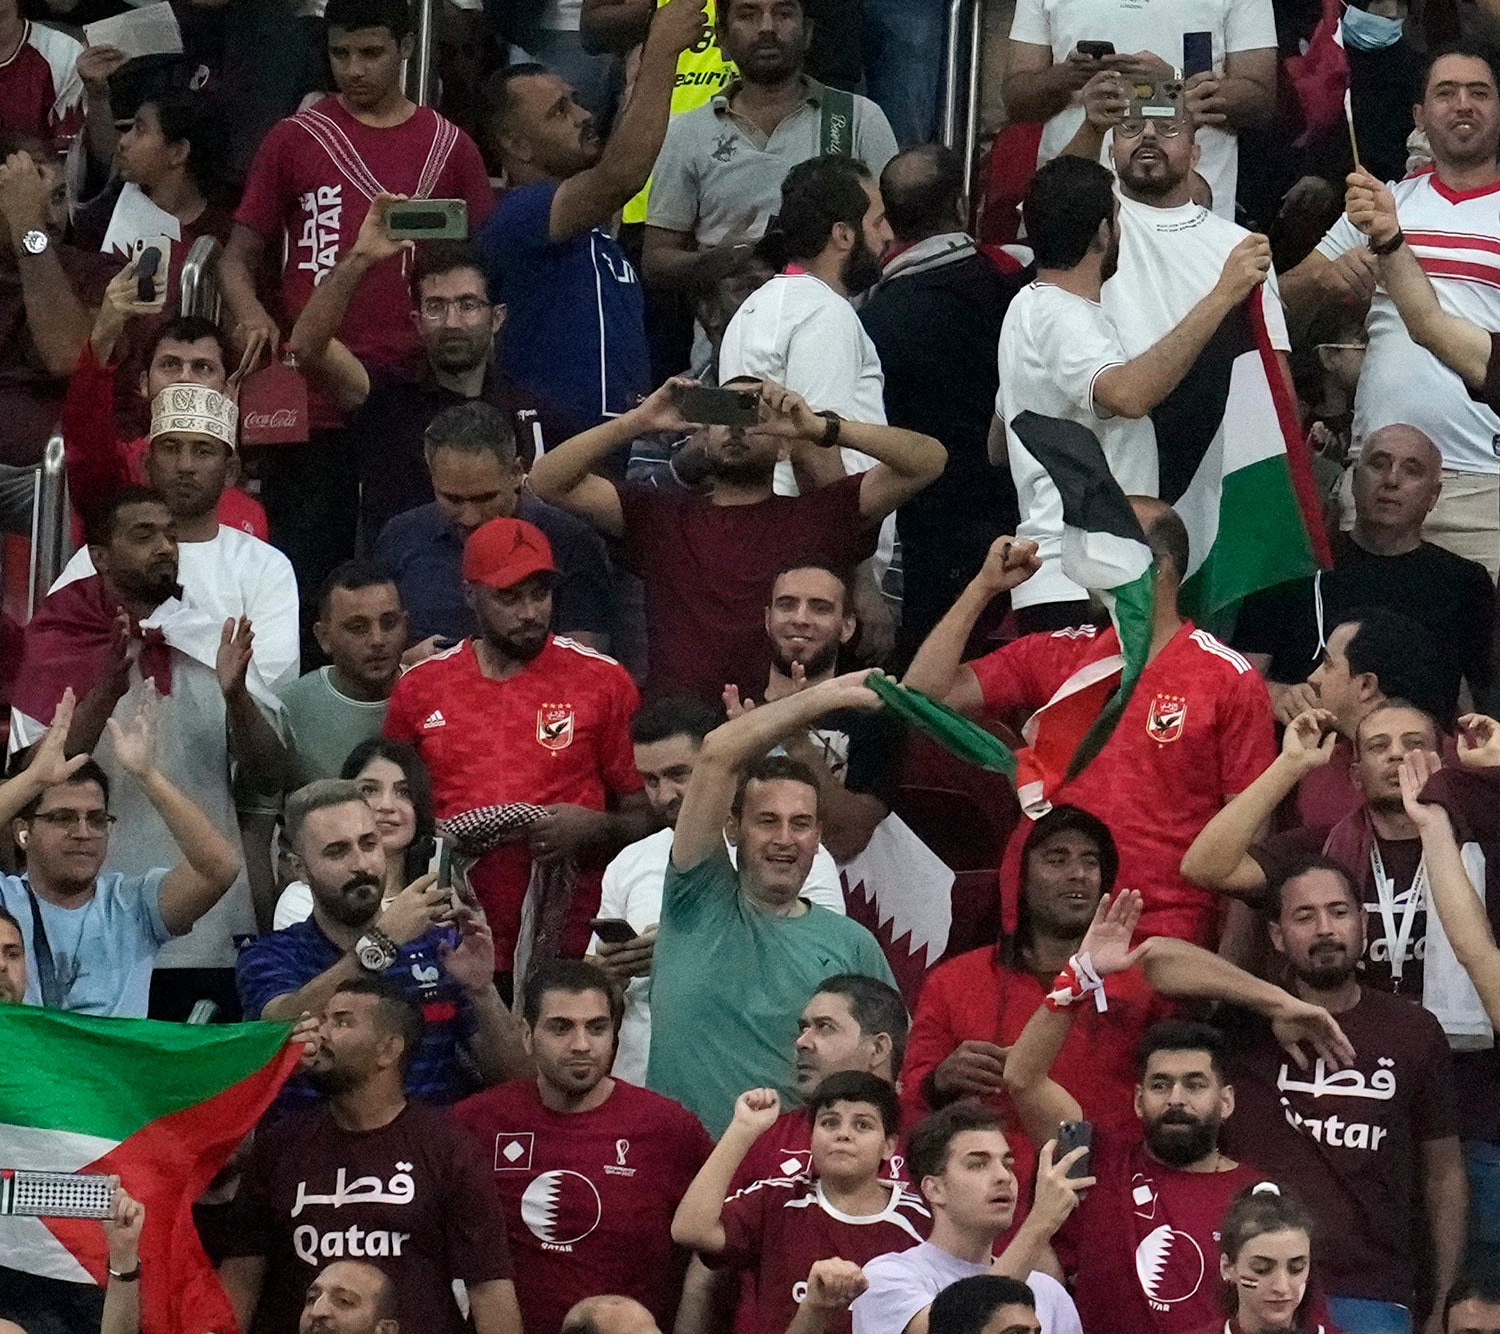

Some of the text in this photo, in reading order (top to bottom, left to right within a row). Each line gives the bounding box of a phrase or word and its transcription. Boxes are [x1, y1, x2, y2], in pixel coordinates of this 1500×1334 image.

[292, 1162, 414, 1217] قطر
[294, 1225, 409, 1265] Qatar
[541, 1241, 573, 1252] QATAR
